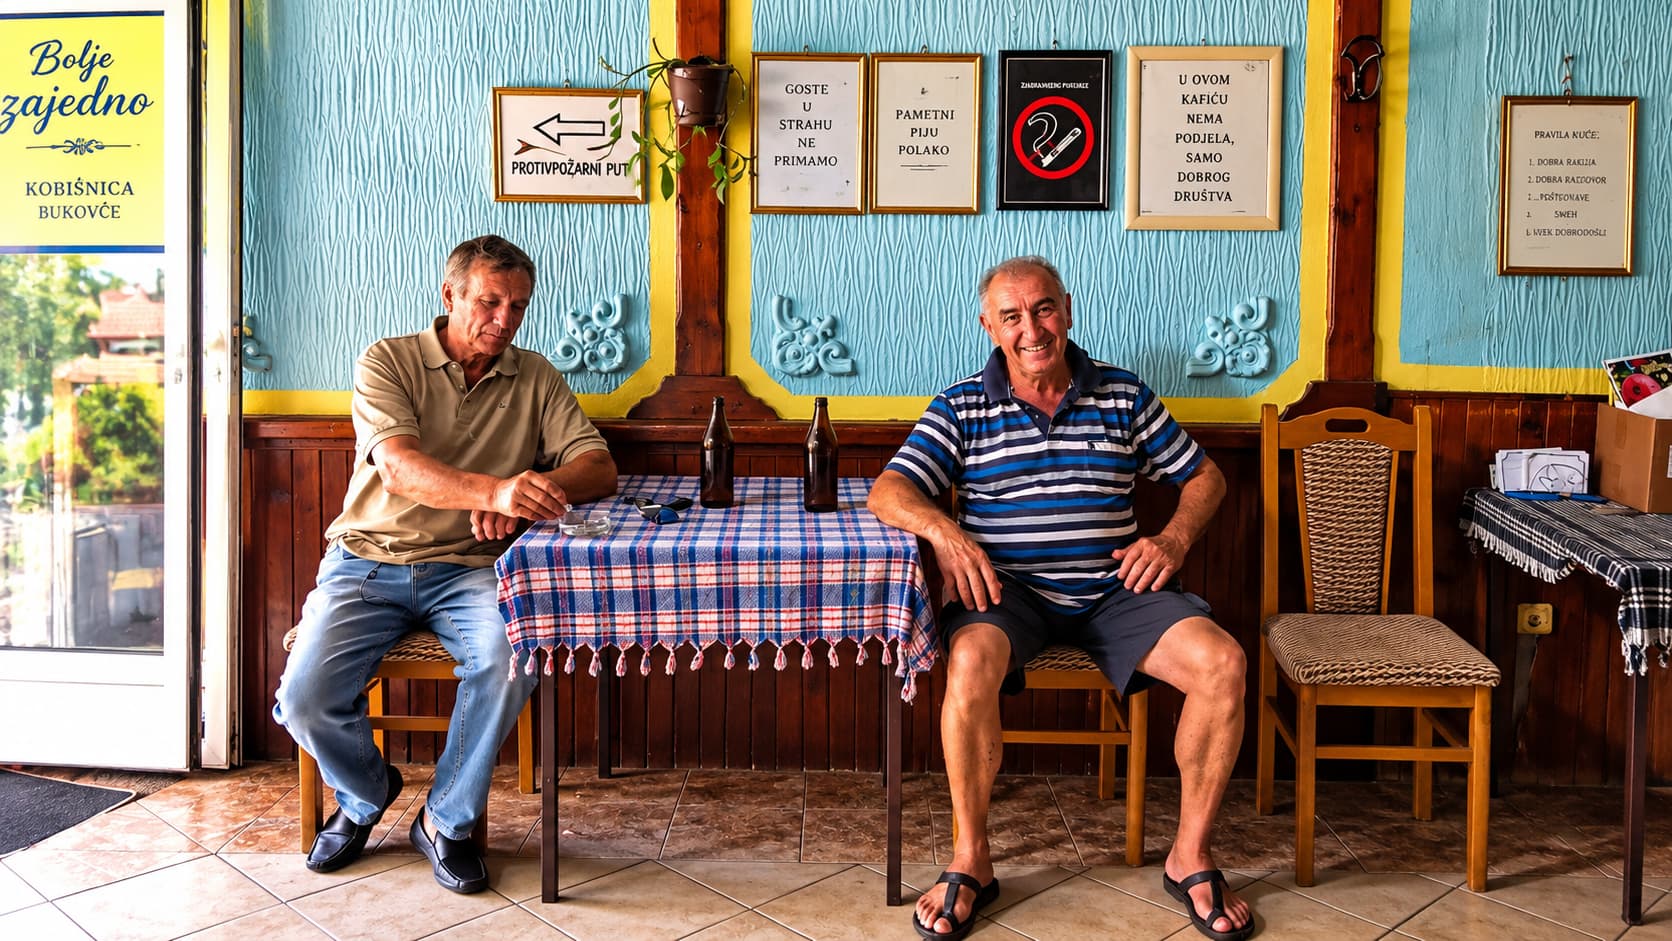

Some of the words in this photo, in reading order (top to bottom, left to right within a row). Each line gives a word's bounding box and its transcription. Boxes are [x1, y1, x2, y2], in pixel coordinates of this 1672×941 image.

[29, 39, 115, 83] Bolje
[1179, 74, 1188, 85] U
[1192, 74, 1230, 85] OVOM
[785, 83, 829, 95] GOSTE
[1181, 91, 1228, 105] KAFIĆU
[0, 75, 154, 135] zajedno
[802, 102, 812, 112] U
[895, 109, 955, 120] PAMETNI
[1186, 113, 1223, 124] NEMA
[779, 119, 832, 131] STRAHU
[910, 127, 939, 138] PIJU
[1534, 130, 1570, 139] PRAVILA
[797, 137, 816, 148] NE
[1175, 133, 1235, 146] PODJELA,
[898, 145, 950, 156] POLAKO
[774, 155, 838, 167] PRIMAMO
[1185, 152, 1223, 164] SAMO
[511, 158, 602, 178] PROTIVPOŽARNI
[606, 162, 629, 177] PUT
[1177, 171, 1231, 183] DOBROG
